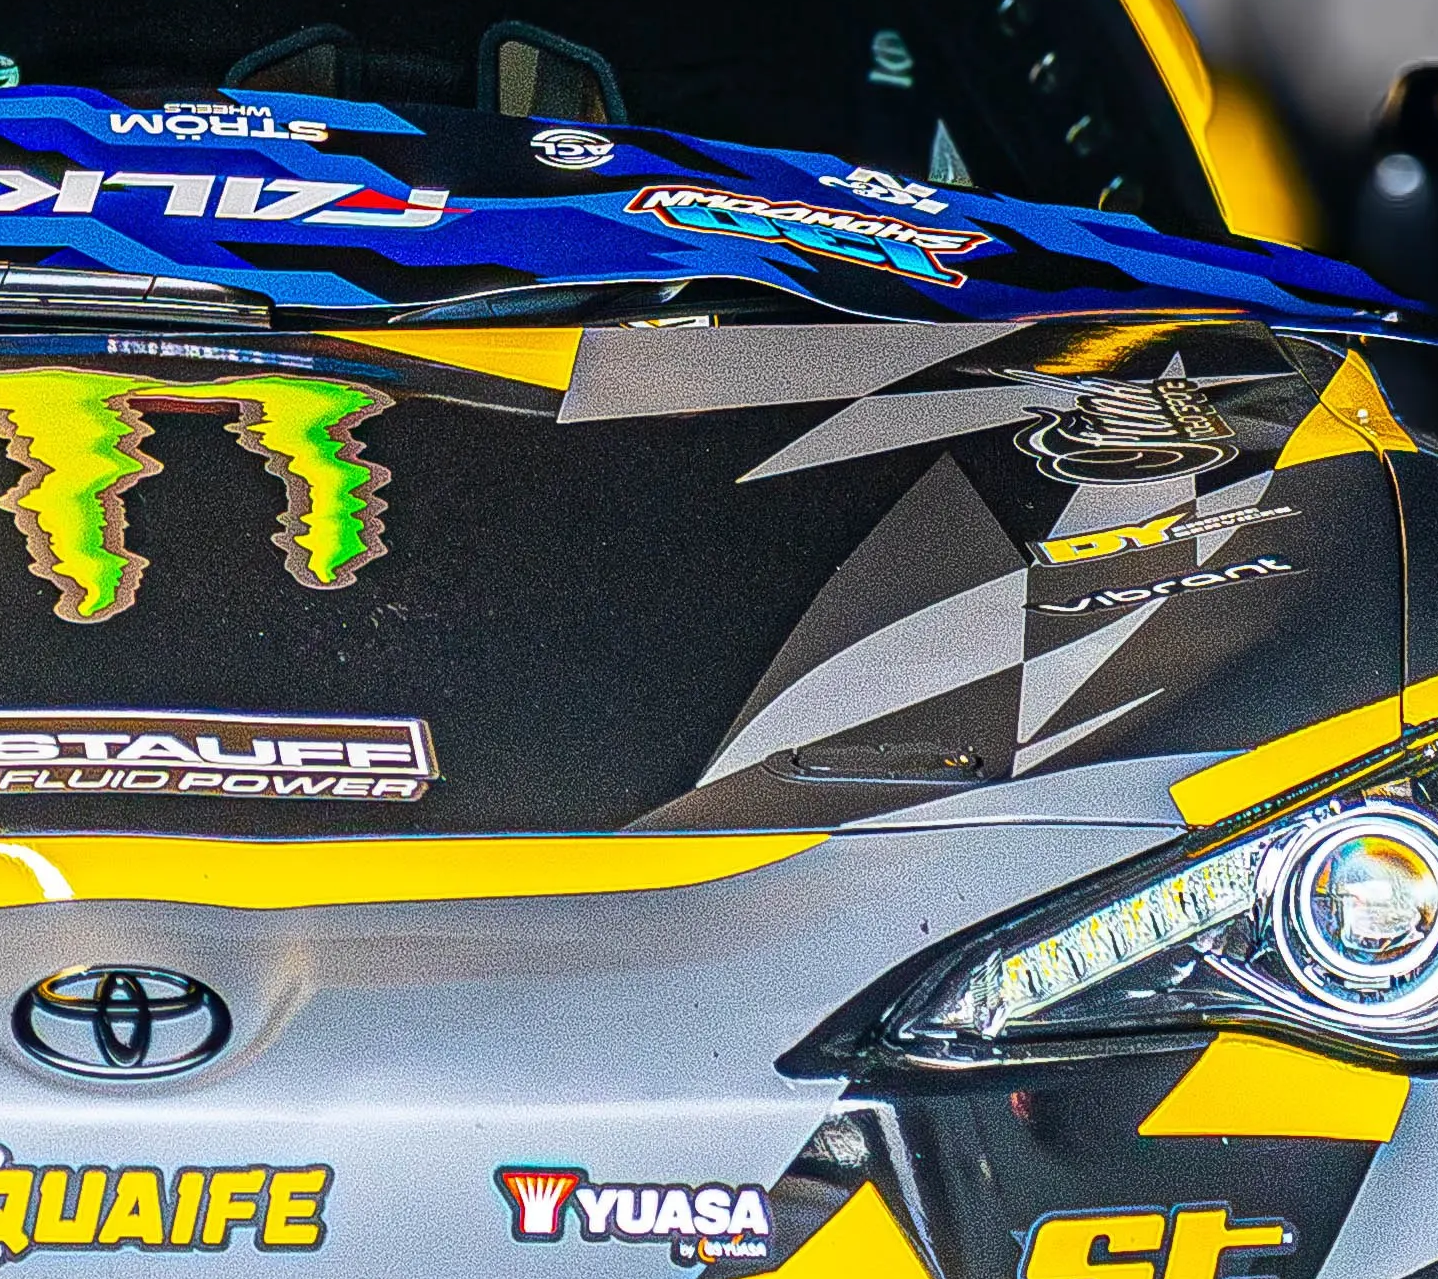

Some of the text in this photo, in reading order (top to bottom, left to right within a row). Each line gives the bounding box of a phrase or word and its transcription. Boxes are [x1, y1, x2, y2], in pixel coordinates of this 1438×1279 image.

[530, 140, 615, 158] ACL
[641, 189, 966, 250] SHOWDOWN
[1039, 512, 1189, 563] DY
[1038, 556, 1292, 611] vibrant
[179, 771, 419, 799] POWER
[575, 1187, 770, 1235] YUASA
